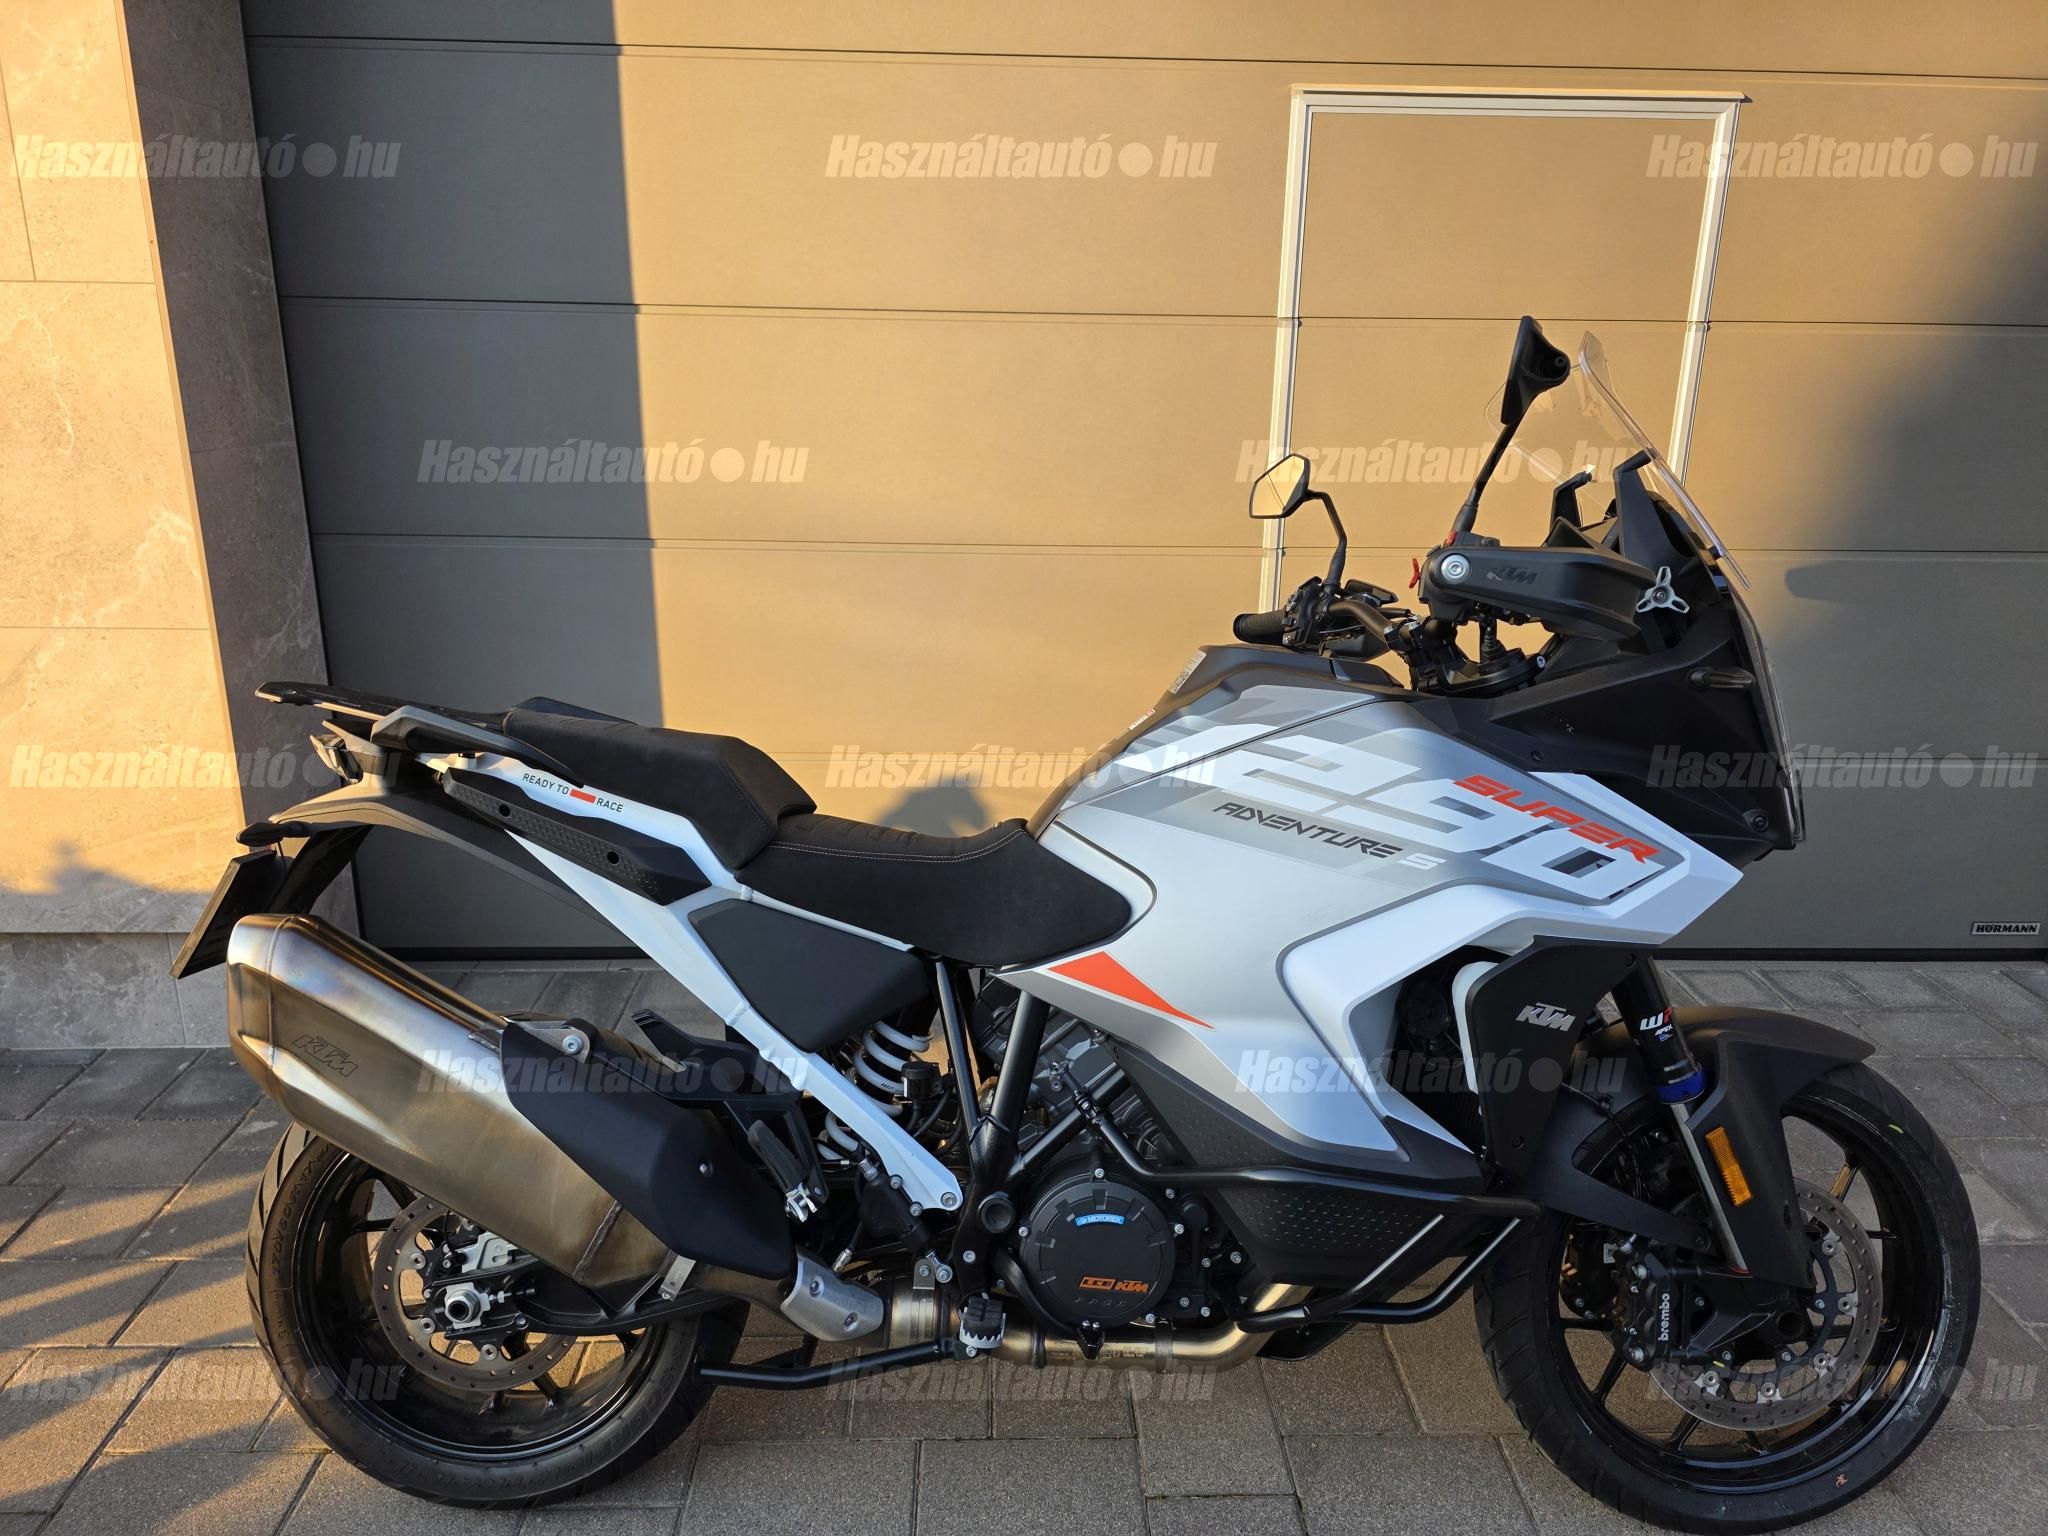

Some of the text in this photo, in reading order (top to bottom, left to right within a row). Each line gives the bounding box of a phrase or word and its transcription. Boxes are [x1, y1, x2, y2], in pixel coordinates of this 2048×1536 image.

[1485, 565, 1538, 584] KTM
[522, 773, 624, 813] READY TO RACE
[1212, 802, 1448, 870] ADVENTURE S
[1454, 774, 1661, 864] SUPER
[1516, 1002, 1576, 1032] KTM
[1640, 1007, 1673, 1031] WP
[291, 1034, 359, 1077] KTM
[1114, 1280, 1149, 1294] KTM
[1658, 1293, 1670, 1341] brembo
